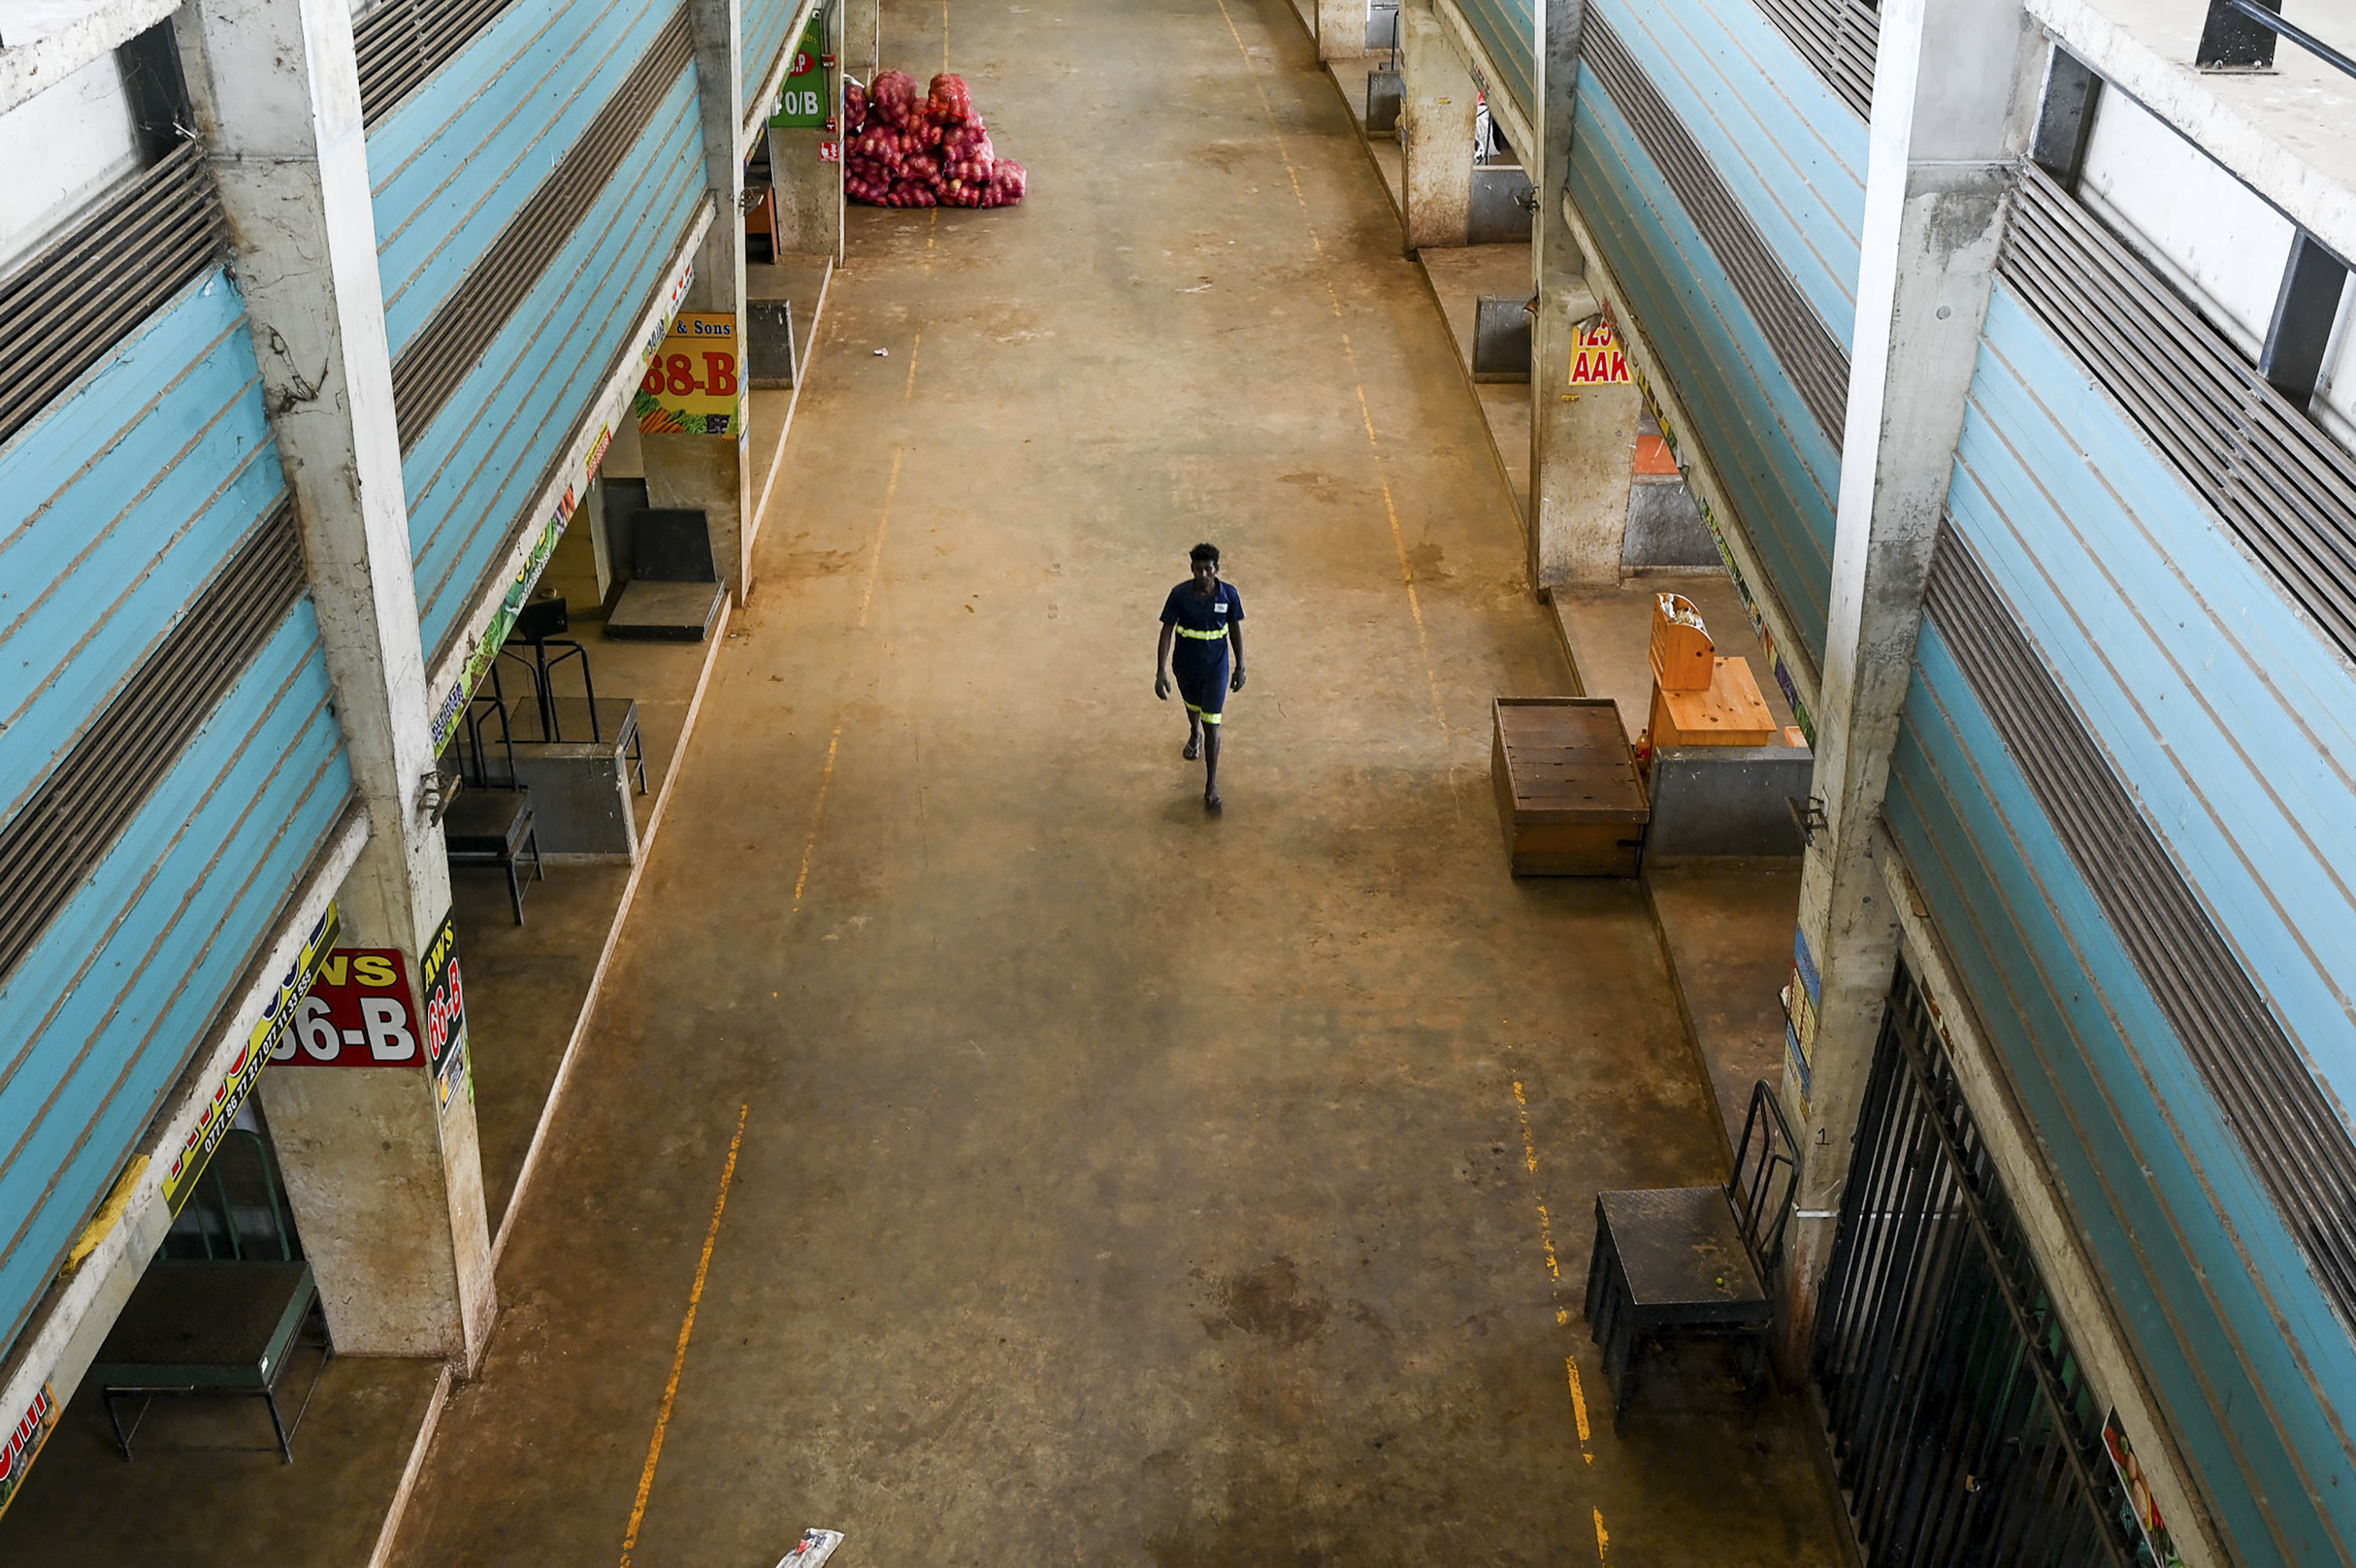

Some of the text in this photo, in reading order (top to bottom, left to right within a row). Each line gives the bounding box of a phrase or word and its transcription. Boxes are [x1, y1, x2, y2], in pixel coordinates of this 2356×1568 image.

[677, 319, 731, 335] & Sons
[641, 352, 737, 396] 68-B
[1571, 351, 1630, 382] AAK
[425, 919, 455, 993] AWS
[428, 957, 462, 1061] 66-B
[204, 1113, 225, 1153] 0777
[225, 1095, 238, 1118] 86
[236, 1075, 247, 1098] 77
[248, 1057, 258, 1081] 27
[262, 1025, 276, 1055] 077
[278, 1010, 287, 1029] 11
[287, 992, 298, 1013] 33
[298, 968, 312, 996] 555
